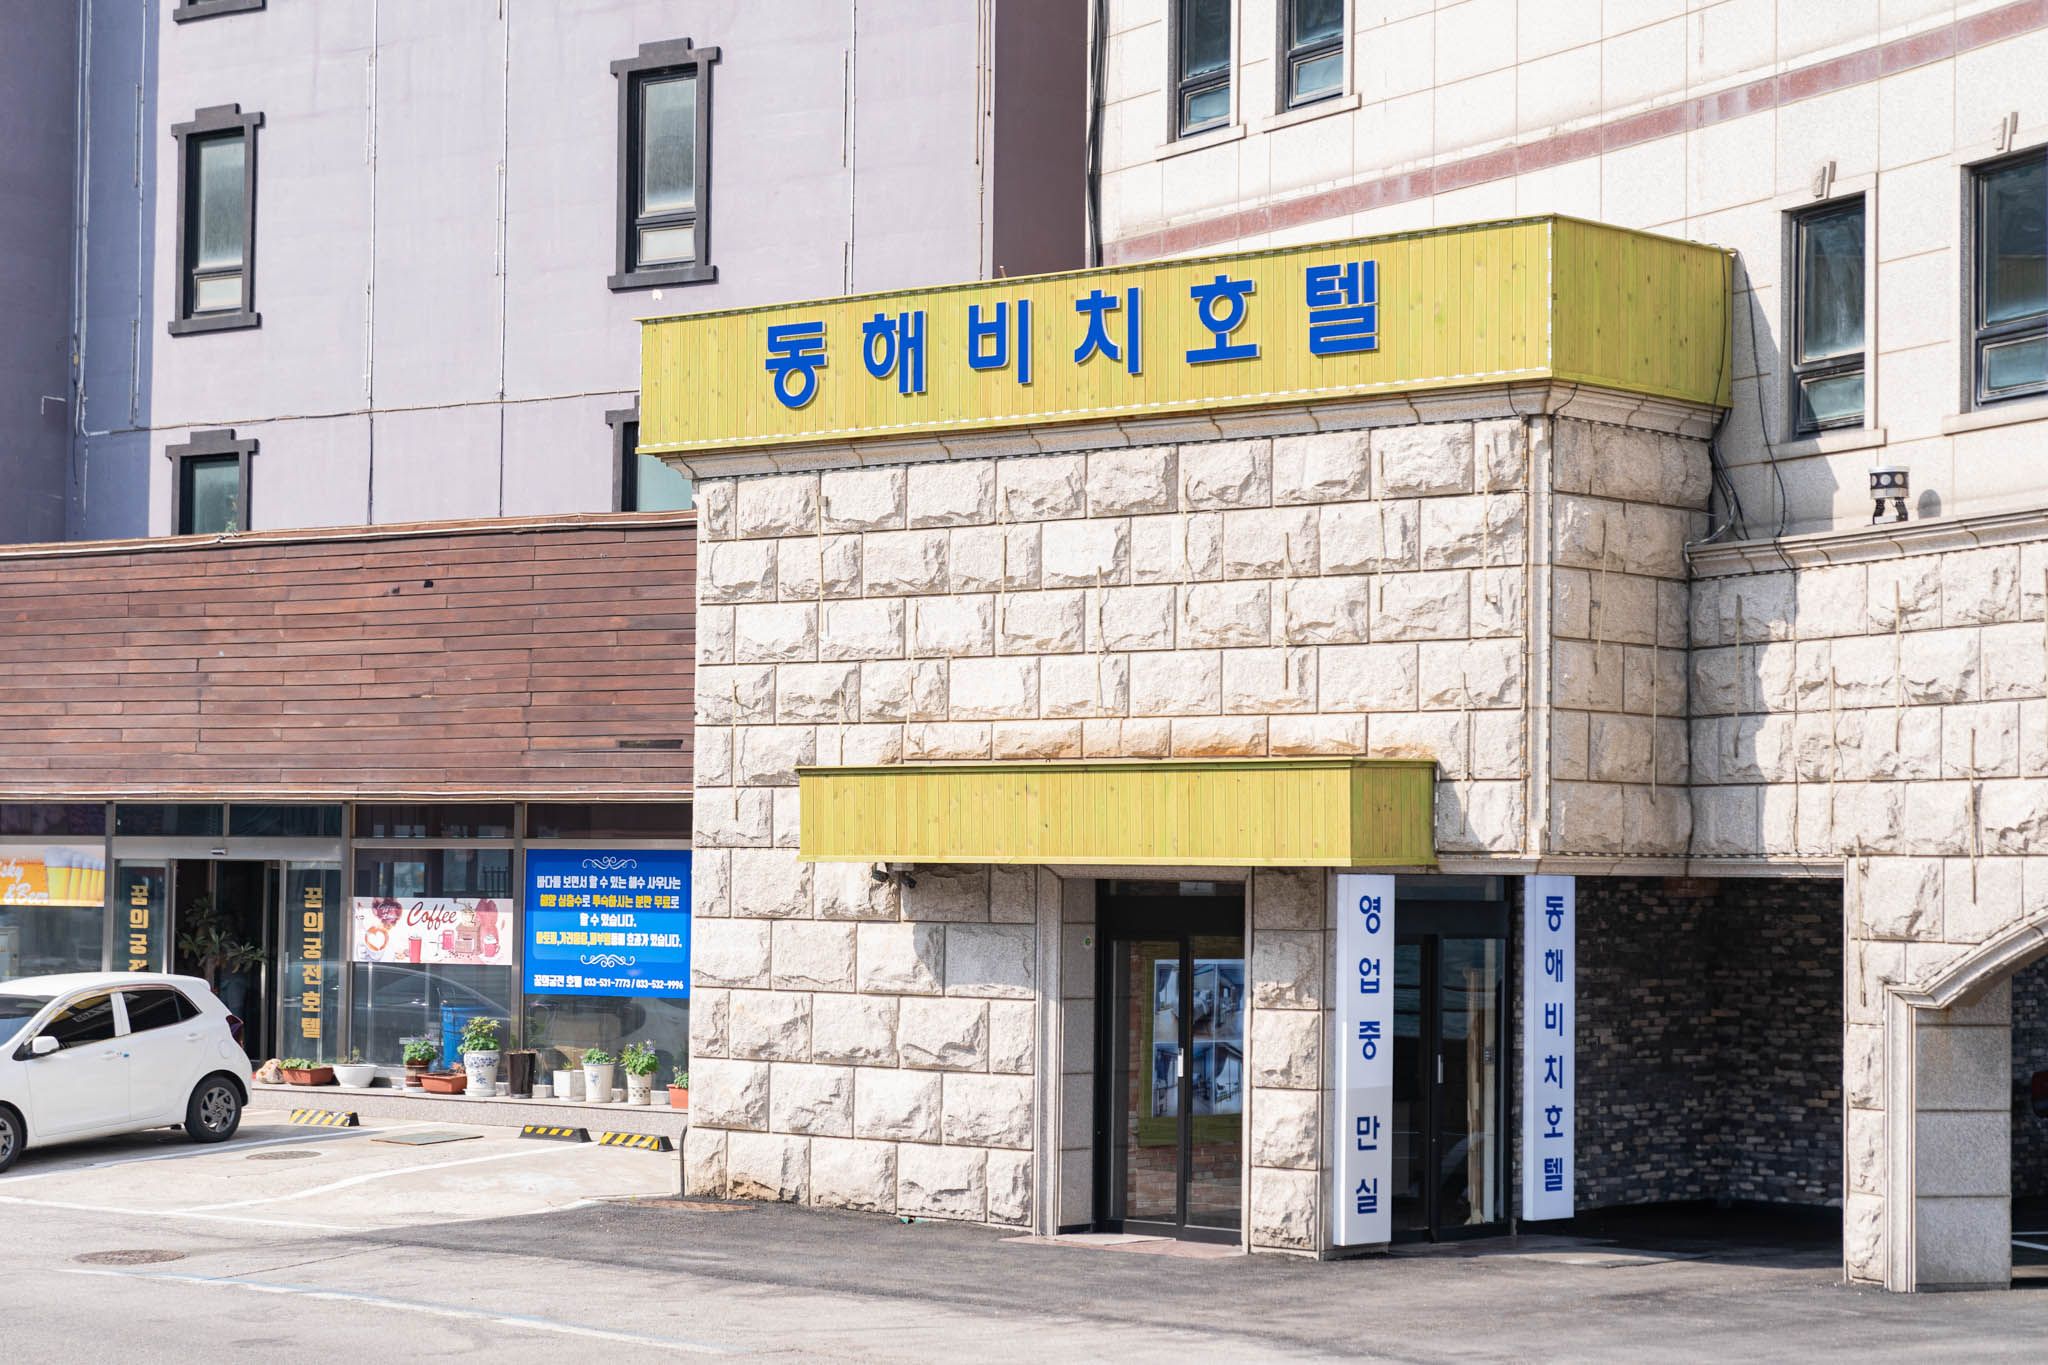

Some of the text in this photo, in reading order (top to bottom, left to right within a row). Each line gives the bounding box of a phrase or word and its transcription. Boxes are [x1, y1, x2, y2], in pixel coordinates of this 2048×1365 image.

[766, 261, 1376, 408] 동해비치호텔
[537, 875, 561, 889] 바다를
[563, 875, 587, 889] 보면서
[610, 876, 626, 889] 있는
[629, 876, 645, 890] 해수
[647, 877, 681, 890] 사우나는
[592, 894, 633, 909] 투숙하시는
[654, 896, 680, 909] 무료로
[407, 901, 457, 931] Coffee
[601, 913, 638, 928] 있습니다.
[626, 933, 649, 947] 효과가
[650, 934, 683, 948] 있습니다.
[1356, 895, 1382, 1215] 영업중 만실
[1543, 895, 1565, 1193] 동해비치호텔
